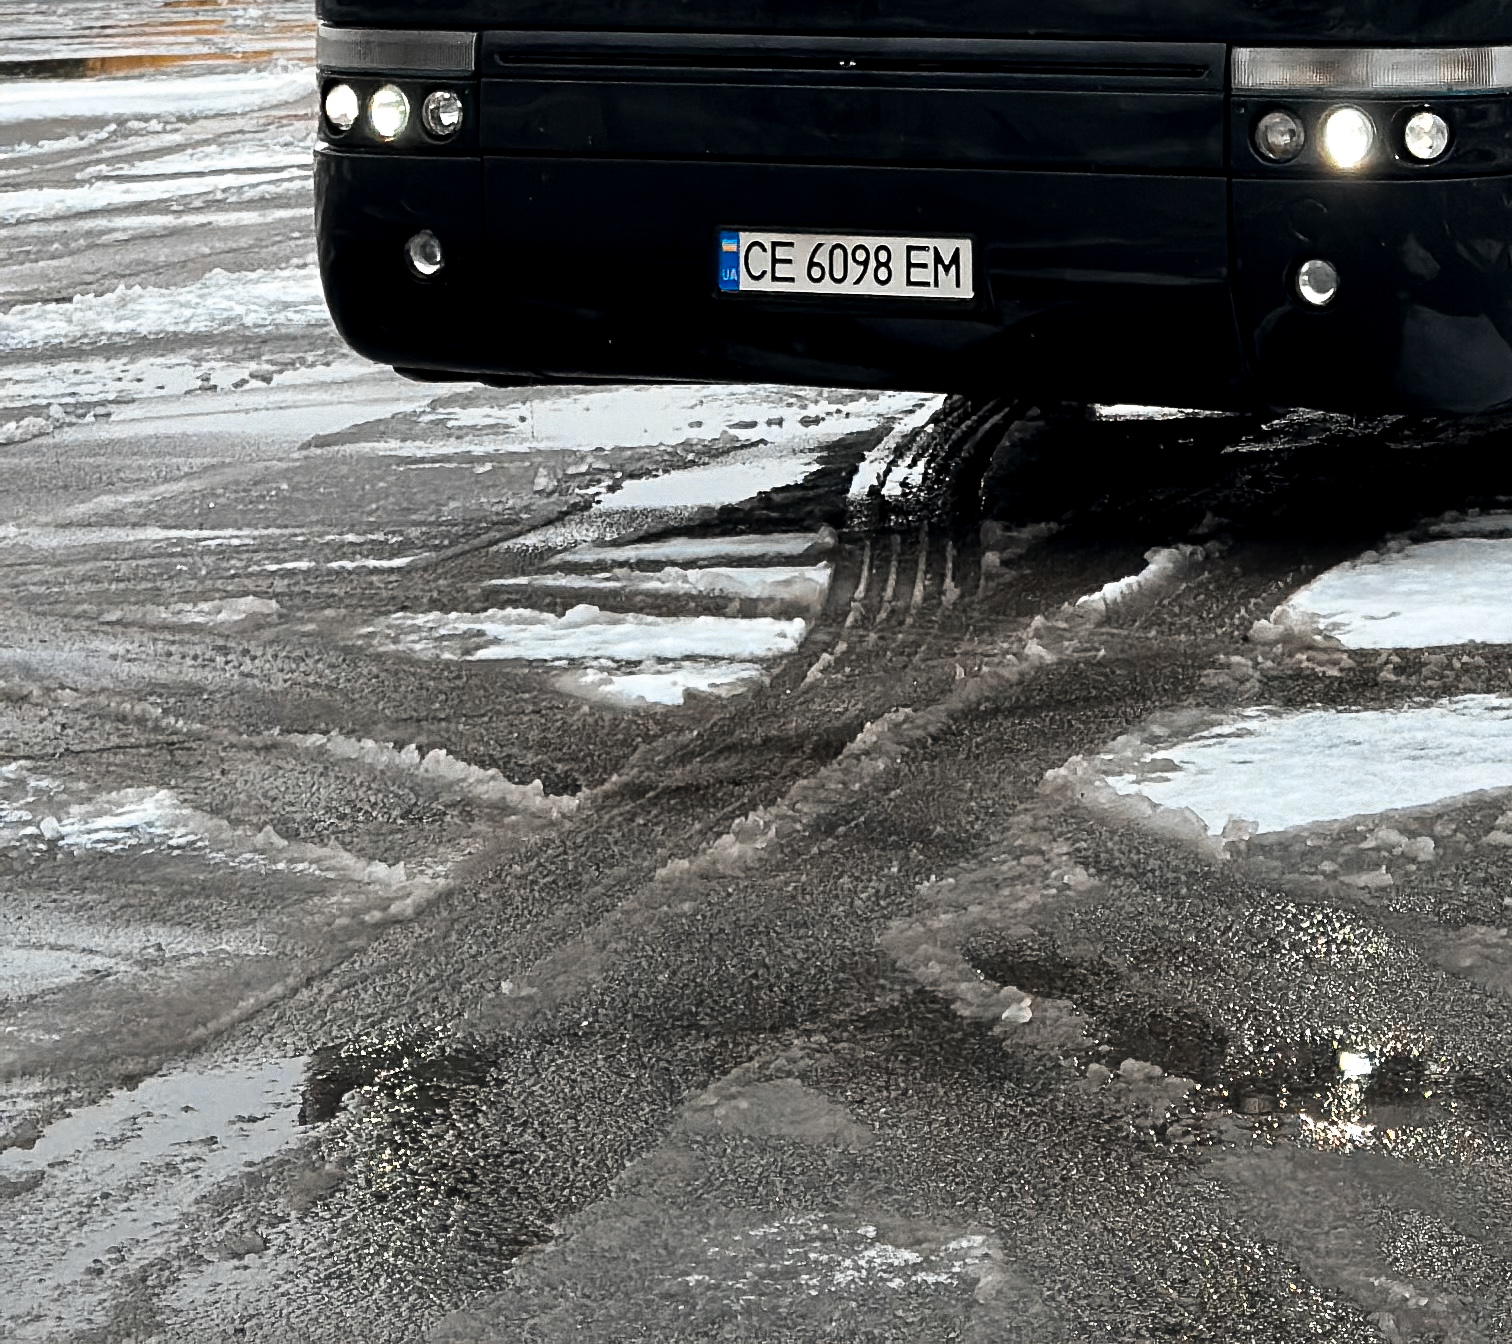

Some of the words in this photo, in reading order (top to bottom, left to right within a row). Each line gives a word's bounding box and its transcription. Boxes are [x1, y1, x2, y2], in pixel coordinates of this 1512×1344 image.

[721, 267, 738, 281] UA
[743, 240, 796, 283] CE
[806, 242, 893, 286] 6098
[905, 244, 961, 288] EM
